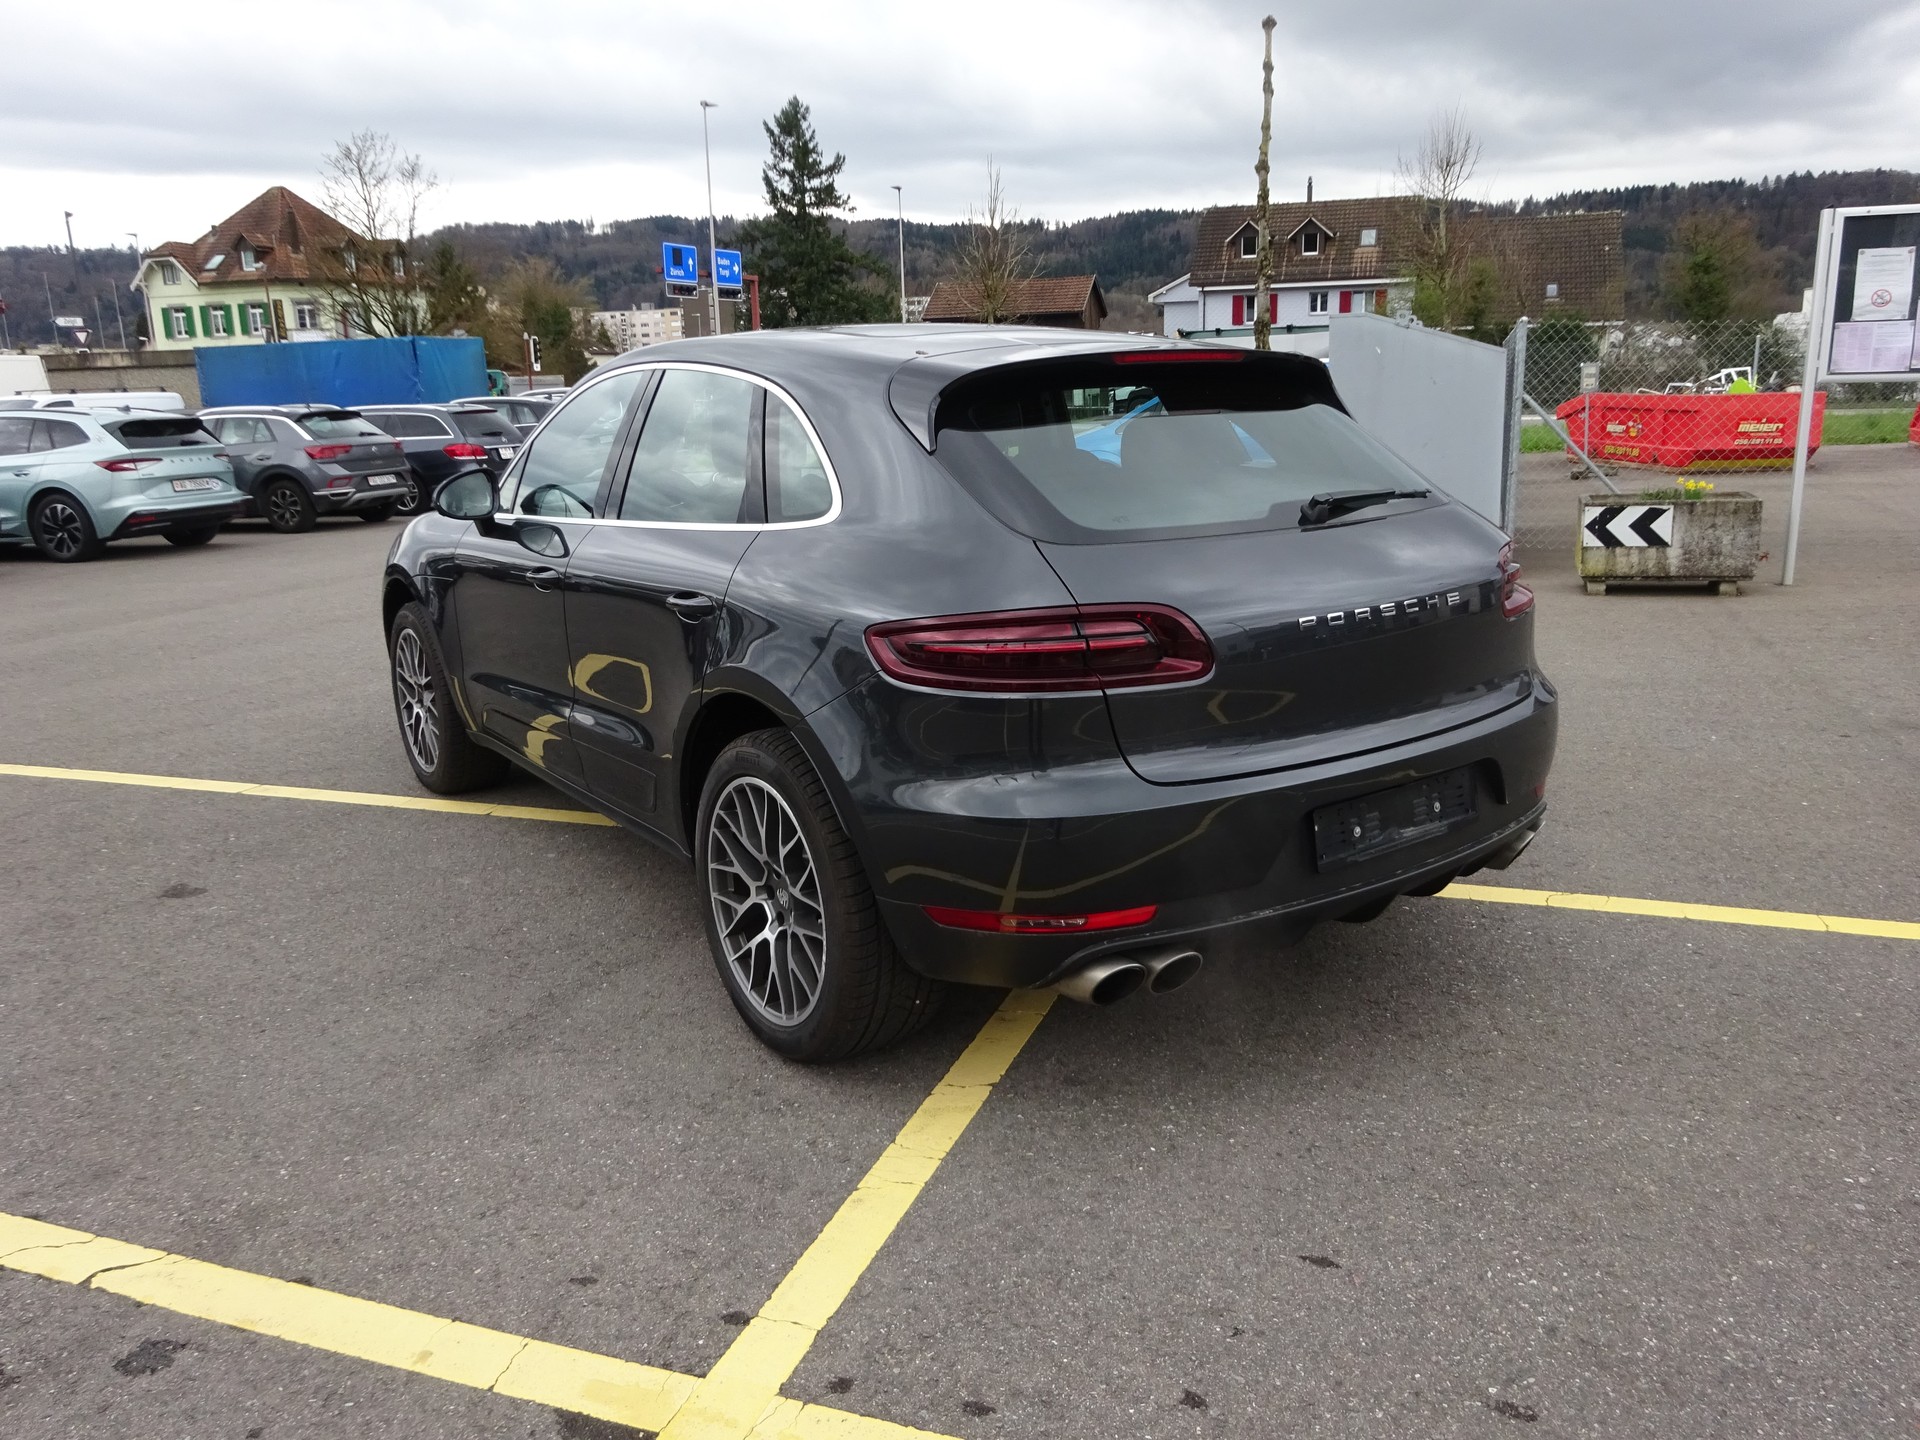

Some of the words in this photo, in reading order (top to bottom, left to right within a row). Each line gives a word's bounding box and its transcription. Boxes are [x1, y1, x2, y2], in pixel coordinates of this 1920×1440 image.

[670, 267, 685, 277] Zürich
[1737, 417, 1784, 433] meier
[1298, 592, 1460, 631] PORSCHE
